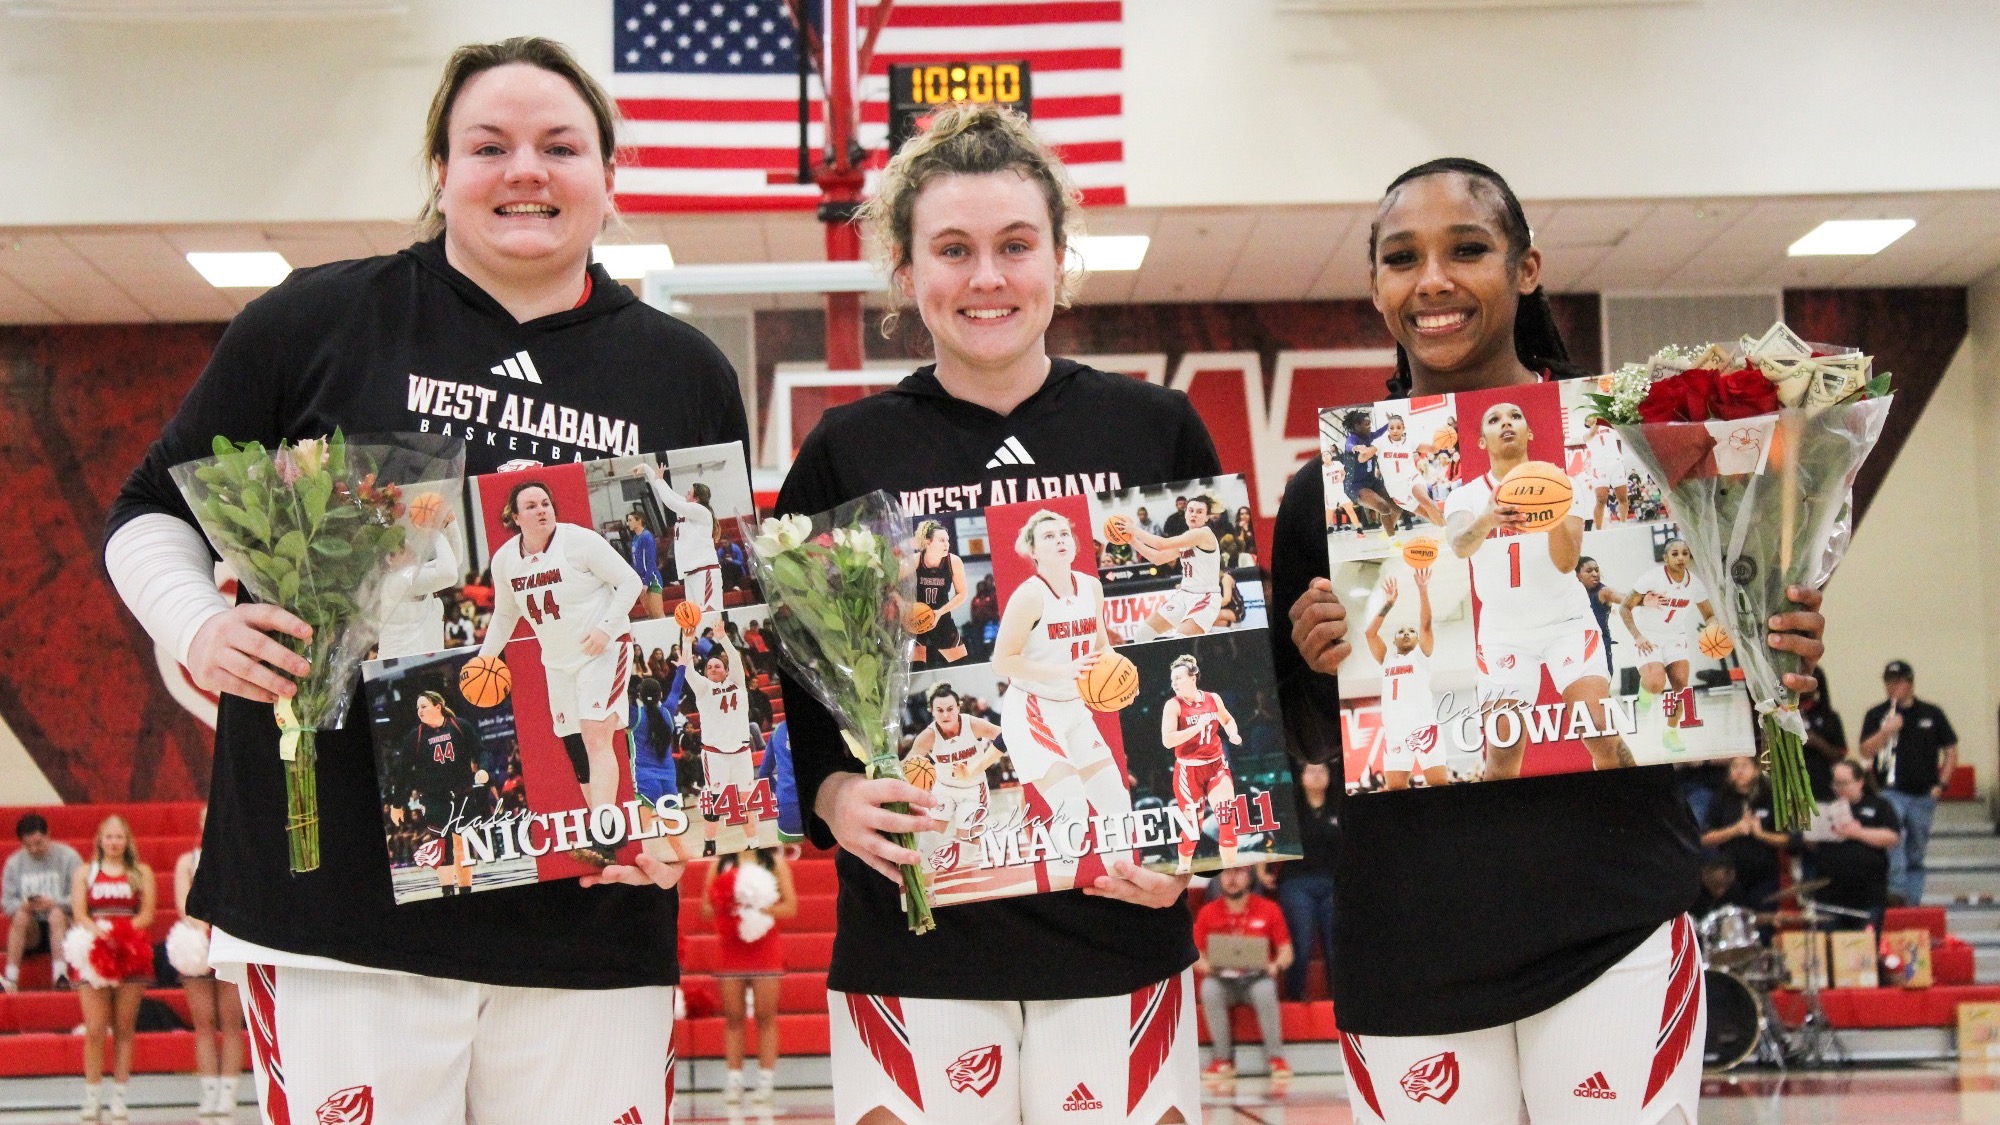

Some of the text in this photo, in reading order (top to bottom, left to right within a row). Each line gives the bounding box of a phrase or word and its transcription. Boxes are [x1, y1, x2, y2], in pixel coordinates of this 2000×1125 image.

[912, 64, 1021, 104] 10:00
[407, 373, 640, 457] WEST ALABAMA
[900, 472, 1122, 517] WEST ALABAMA
[1507, 542, 1521, 588] 1
[526, 590, 561, 625] 44
[1047, 621, 1071, 640] WEST
[1071, 640, 1090, 662] 11
[719, 692, 738, 714] 44
[1434, 688, 1534, 725] Callie
[1451, 686, 1704, 753] COWAN #1
[433, 741, 455, 764] 44
[428, 796, 537, 839] Haley
[461, 777, 780, 867] NICHOLS #44
[960, 802, 1070, 842] Bellah
[979, 791, 1282, 870] MACHEN #11
[1062, 1099, 1104, 1112] adidas
[1573, 1087, 1617, 1100] adidas
